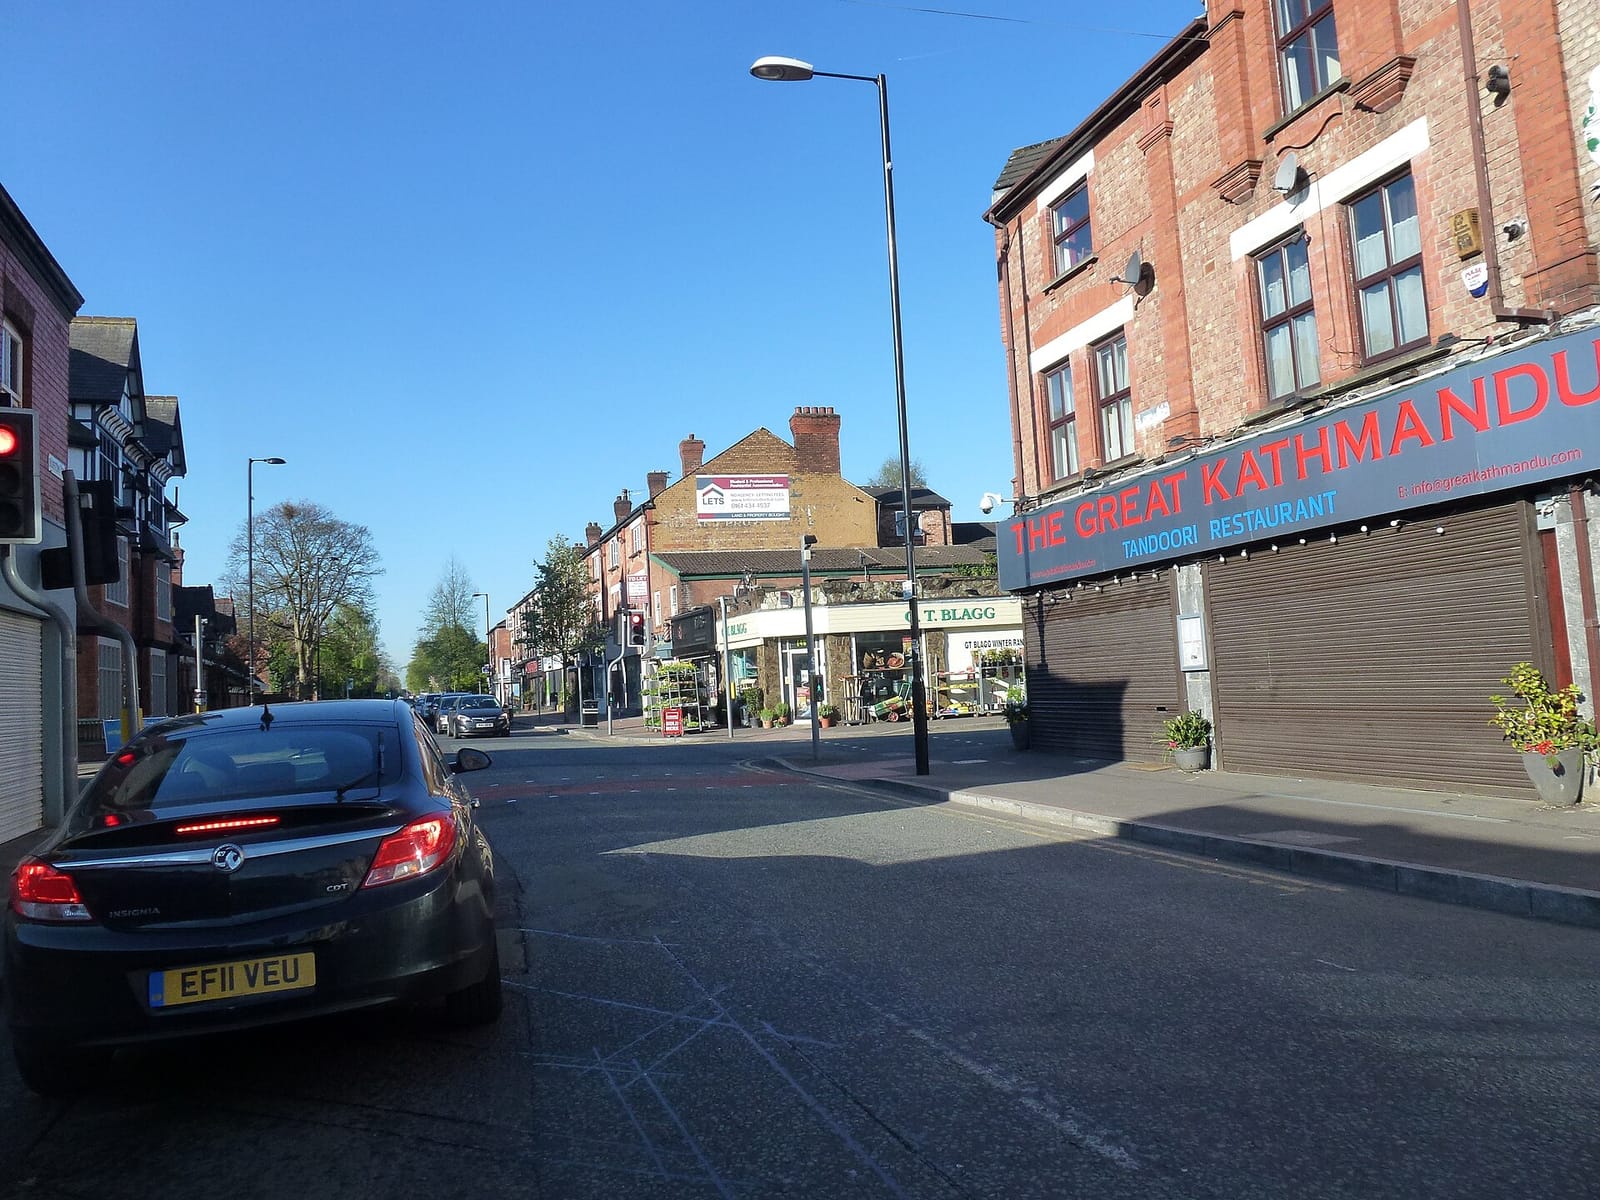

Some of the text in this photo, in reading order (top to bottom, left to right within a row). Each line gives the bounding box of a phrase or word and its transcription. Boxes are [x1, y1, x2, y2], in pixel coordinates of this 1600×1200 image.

[1010, 339, 1600, 554] THE GREAT KATHMANDU
[1398, 447, 1583, 498] E: info@greatkathmandu.com
[702, 497, 725, 505] LETS
[1123, 490, 1337, 559] TANDOORI RESTAURANT
[923, 610, 938, 622] T.
[941, 607, 996, 621] BLAGG
[965, 641, 972, 649] GT
[973, 640, 991, 649] BLAGG
[992, 638, 1012, 648] WINTER
[109, 907, 161, 918] INSIGNIA
[181, 957, 299, 997] EF11 VEU
